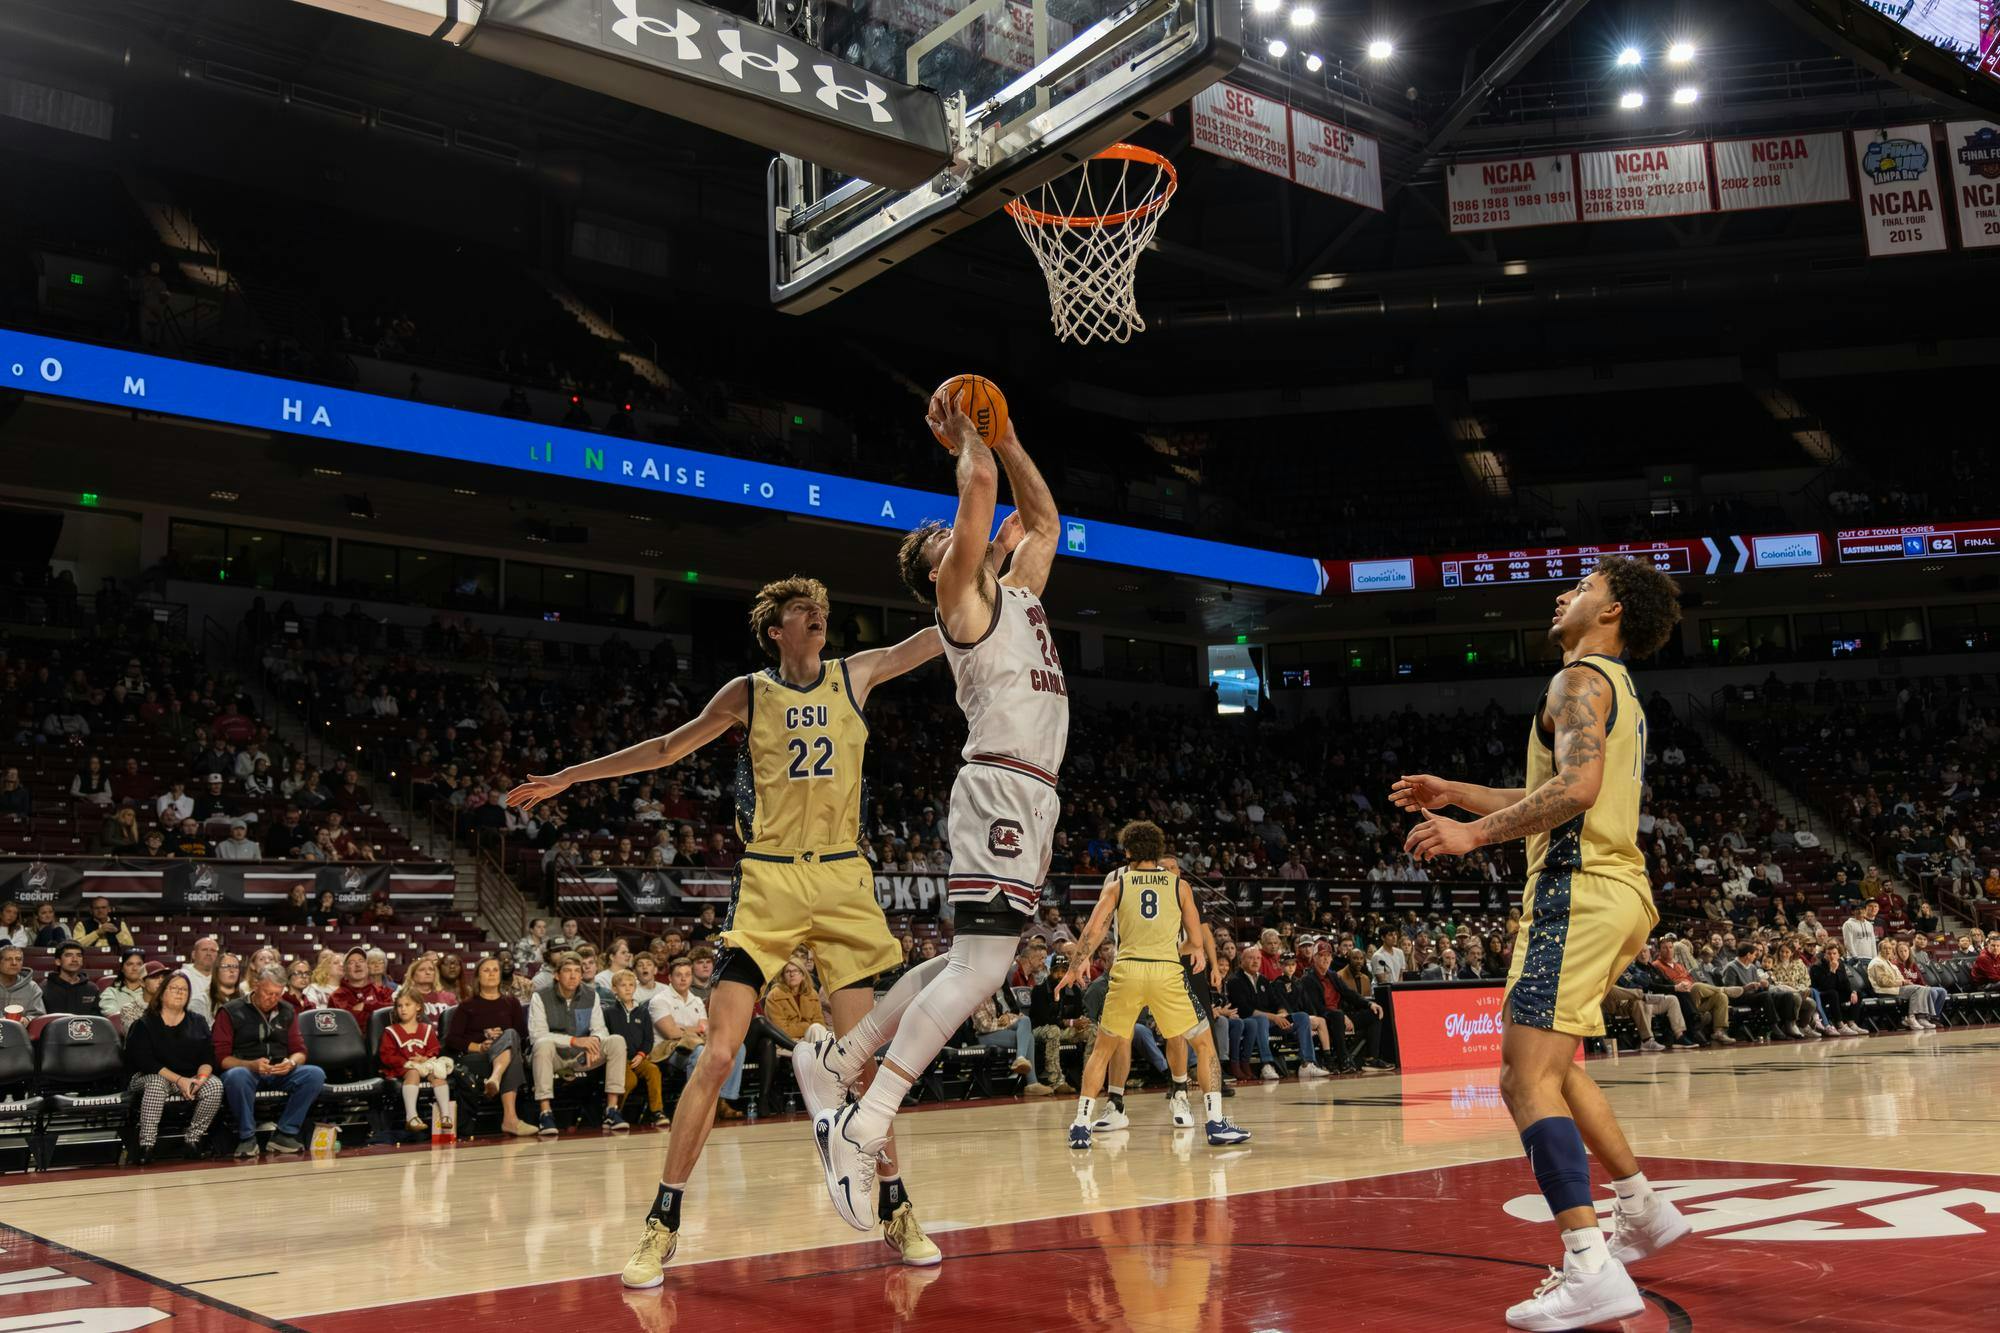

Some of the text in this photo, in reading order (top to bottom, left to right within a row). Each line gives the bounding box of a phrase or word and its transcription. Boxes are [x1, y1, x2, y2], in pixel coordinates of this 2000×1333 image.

[1226, 90, 1254, 117] SEC
[1195, 113, 1218, 130] 2015
[1324, 126, 1349, 153] SEC
[1751, 138, 1808, 163] NCAA
[1961, 149, 1990, 161] FINAL
[1296, 151, 1317, 167] 2025
[1615, 151, 1669, 174] NCAA
[1483, 162, 1536, 185] NCAA
[1627, 174, 1649, 183] SWEET
[1873, 169, 1919, 184] TAMPA BAY
[1490, 184, 1532, 195] TOURNAMENT
[1647, 184, 1675, 197] 2012
[1677, 181, 1706, 194] 2014
[1721, 174, 1781, 190] 2002 2018
[1452, 199, 1479, 212] 1986
[1514, 194, 1541, 207] 1989
[1545, 191, 1572, 204] 1991
[1869, 189, 1933, 216] NCAA
[1962, 183, 2000, 208] NC
[1584, 200, 1645, 214] 2016 2019
[1975, 210, 1998, 219] FINAL
[1452, 210, 1511, 225] 2003 2013
[1882, 215, 1926, 227] FINAL FOUR
[1889, 228, 1923, 243] 2015
[1984, 221, 2000, 235] 20
[123, 376, 146, 397] M
[283, 398, 332, 428] HA
[622, 458, 706, 488] RAISE
[809, 484, 820, 507] E
[881, 500, 896, 519] A
[1837, 525, 1935, 538] OUT OF TOWN SCORES
[1843, 543, 1903, 554] EASTERN ILLINOIS
[1932, 539, 1953, 550] 62
[1964, 538, 1995, 547] FINAL
[1761, 549, 1812, 559] Colonial Life
[1473, 563, 1494, 572] 6/15
[1508, 561, 1530, 569] 40.0
[1546, 559, 1563, 567] 2/6
[1357, 571, 1407, 583] Colonial Life
[1474, 574, 1495, 582] 4/12
[1548, 570, 1562, 578] 1/5
[1036, 628, 1062, 671] 24
[1030, 668, 1068, 697] CAROLI
[785, 704, 828, 731] CSU
[788, 735, 835, 780] 22
[1131, 875, 1169, 886] WILLIAMS
[19, 892, 54, 901] COCKPIT
[188, 892, 220, 901] COCKPIT
[1140, 888, 1159, 921] 8
[1476, 997, 1501, 1007] VISIT
[1445, 1013, 1494, 1043] Myrtle
[1462, 1045, 1488, 1054] SOUTH
[333, 1083, 374, 1093] GAMECOCKS
[73, 1098, 122, 1106] GAMECOCKS
